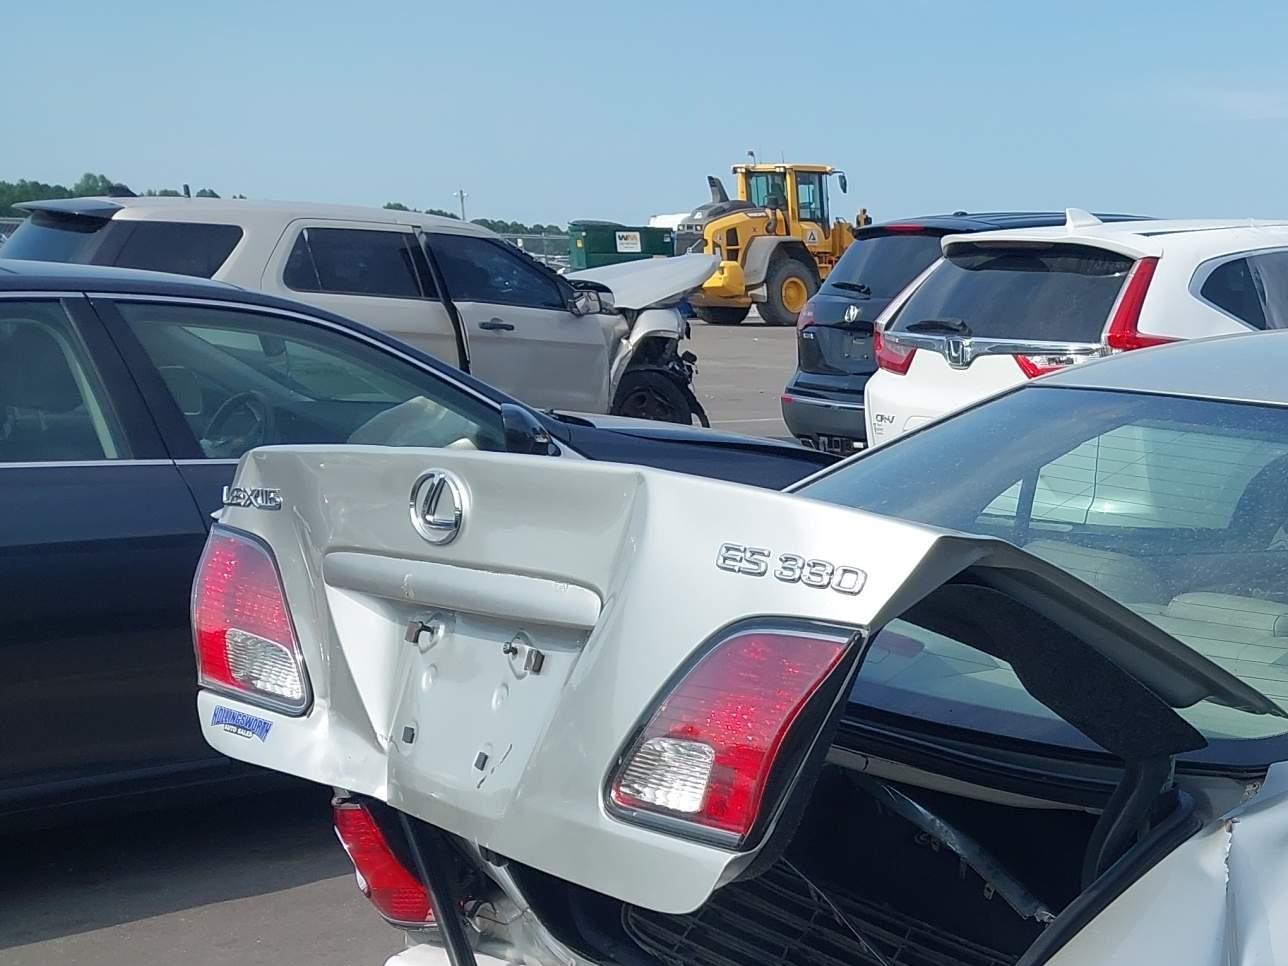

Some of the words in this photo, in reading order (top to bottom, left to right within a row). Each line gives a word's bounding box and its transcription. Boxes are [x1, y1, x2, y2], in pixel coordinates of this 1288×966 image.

[222, 485, 284, 511] LEXUS
[715, 542, 771, 577] ES
[773, 553, 868, 596] 330
[211, 704, 273, 742] HOLLINGSWORTH
